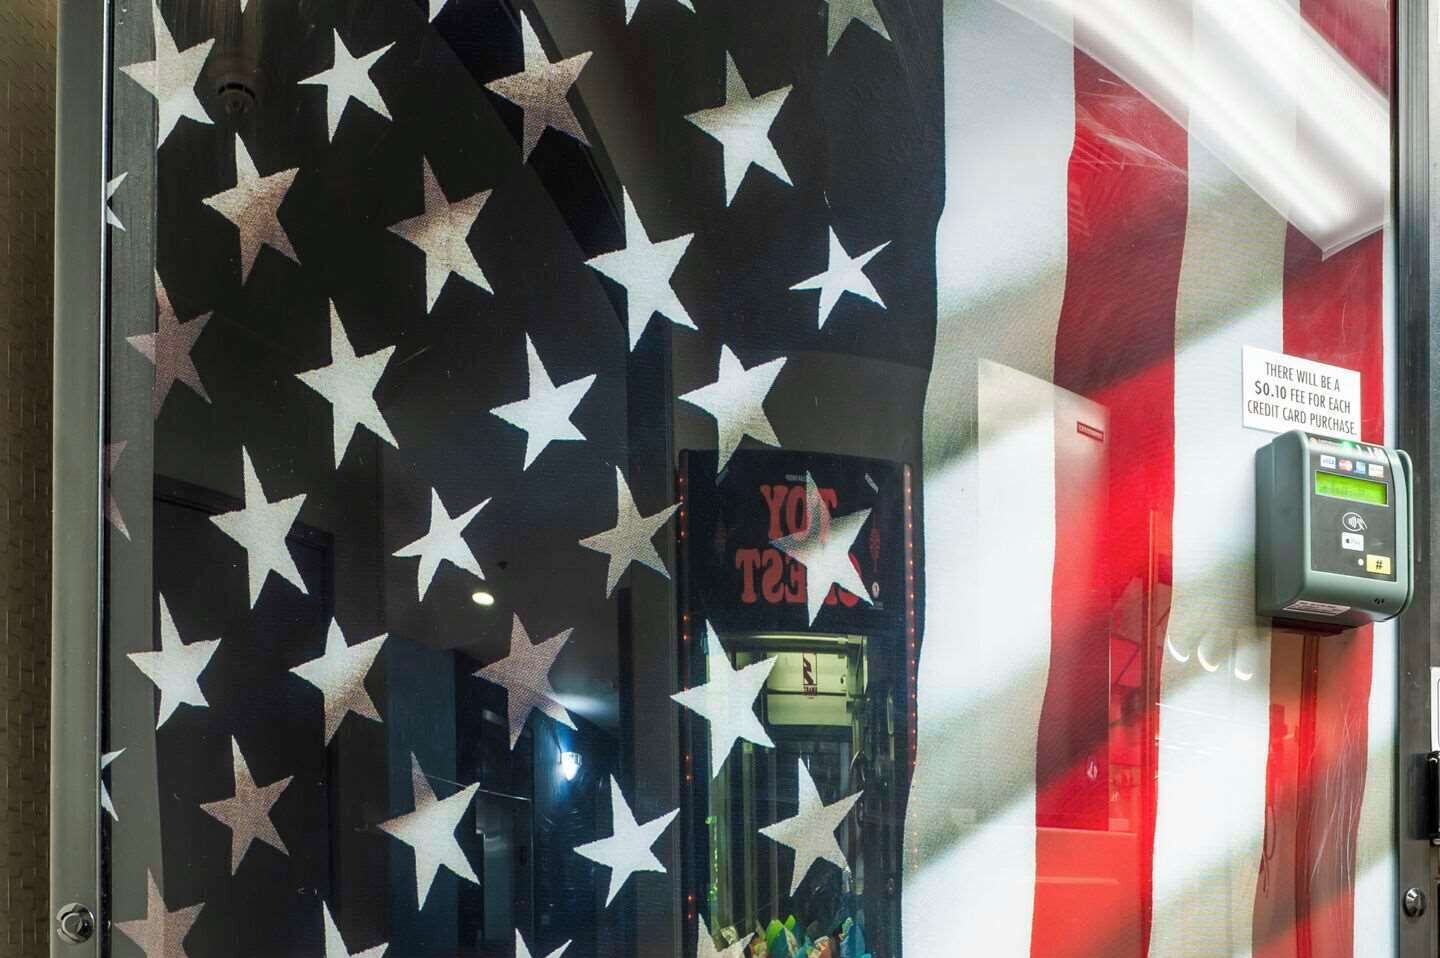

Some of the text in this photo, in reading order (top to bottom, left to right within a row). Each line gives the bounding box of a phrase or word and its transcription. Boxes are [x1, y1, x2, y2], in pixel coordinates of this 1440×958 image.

[1265, 362, 1340, 392] THERE WILL BE A
[1247, 400, 1280, 419] CREDIT
[1283, 407, 1306, 424] CARD
[1255, 380, 1351, 414] $0.10 FEE FOR EACH
